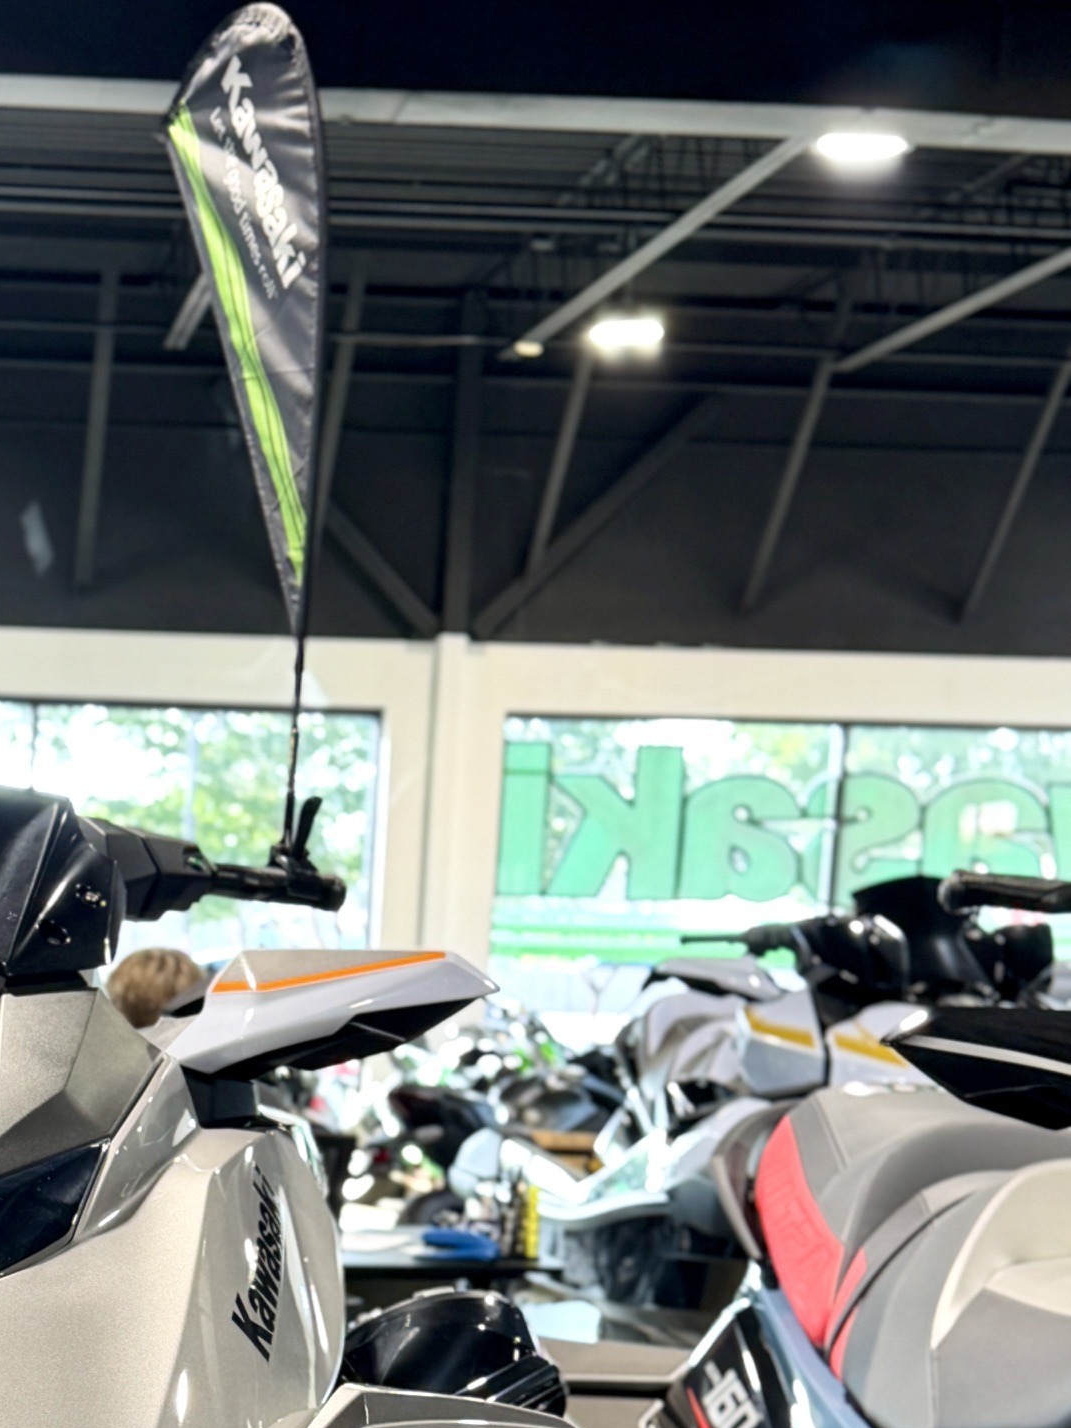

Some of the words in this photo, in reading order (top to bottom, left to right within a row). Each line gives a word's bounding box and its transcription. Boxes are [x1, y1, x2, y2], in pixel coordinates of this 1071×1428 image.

[221, 55, 306, 289] Kawasaki
[225, 169, 247, 214] good
[238, 213, 262, 265] times
[231, 1165, 283, 1363] Kawasaki
